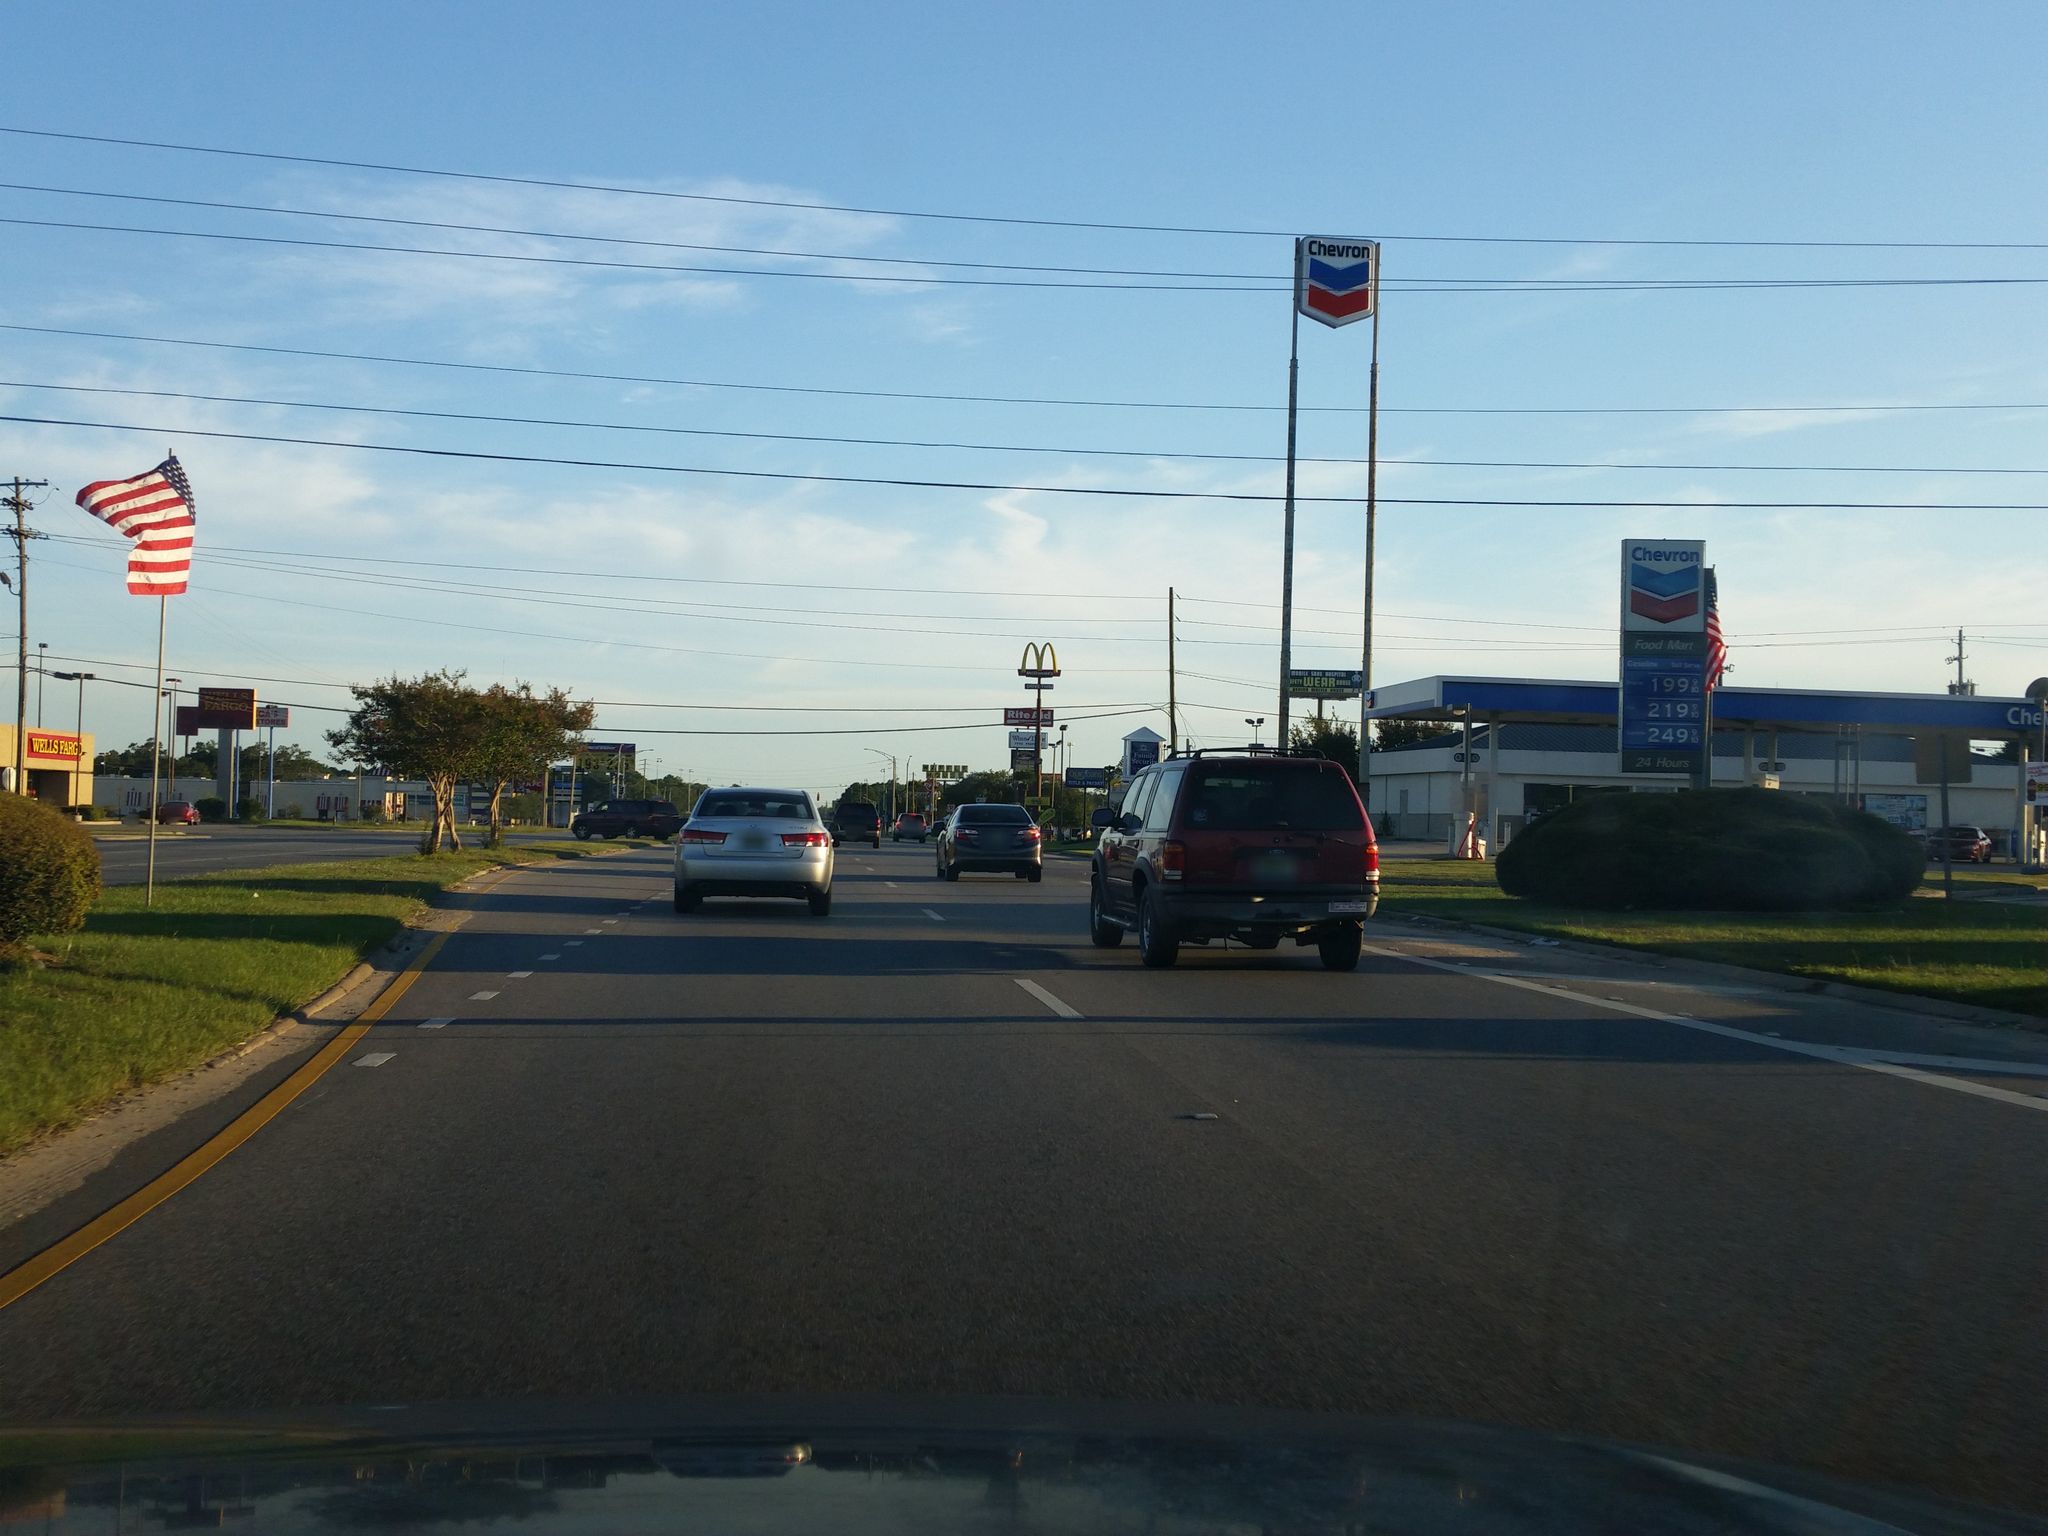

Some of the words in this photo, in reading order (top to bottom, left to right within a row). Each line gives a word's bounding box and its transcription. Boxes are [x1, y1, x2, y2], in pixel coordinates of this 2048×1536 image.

[1308, 240, 1370, 259] Chevron
[1631, 546, 1700, 563] Chevron
[1634, 639, 1663, 650] Food
[1667, 640, 1694, 650] Mart
[1303, 676, 1336, 687] WEAR
[1651, 678, 1689, 693] 199
[203, 701, 248, 711] FARGO
[1647, 702, 1689, 718] 219
[1007, 709, 1031, 719] Rite
[1647, 727, 1689, 743] 249
[32, 737, 59, 754] WELLS
[59, 740, 83, 756] FARGO
[1133, 751, 1156, 760] Family
[1132, 758, 1158, 766] Security
[1635, 757, 1651, 767] 24
[1656, 756, 1691, 768] Hours
